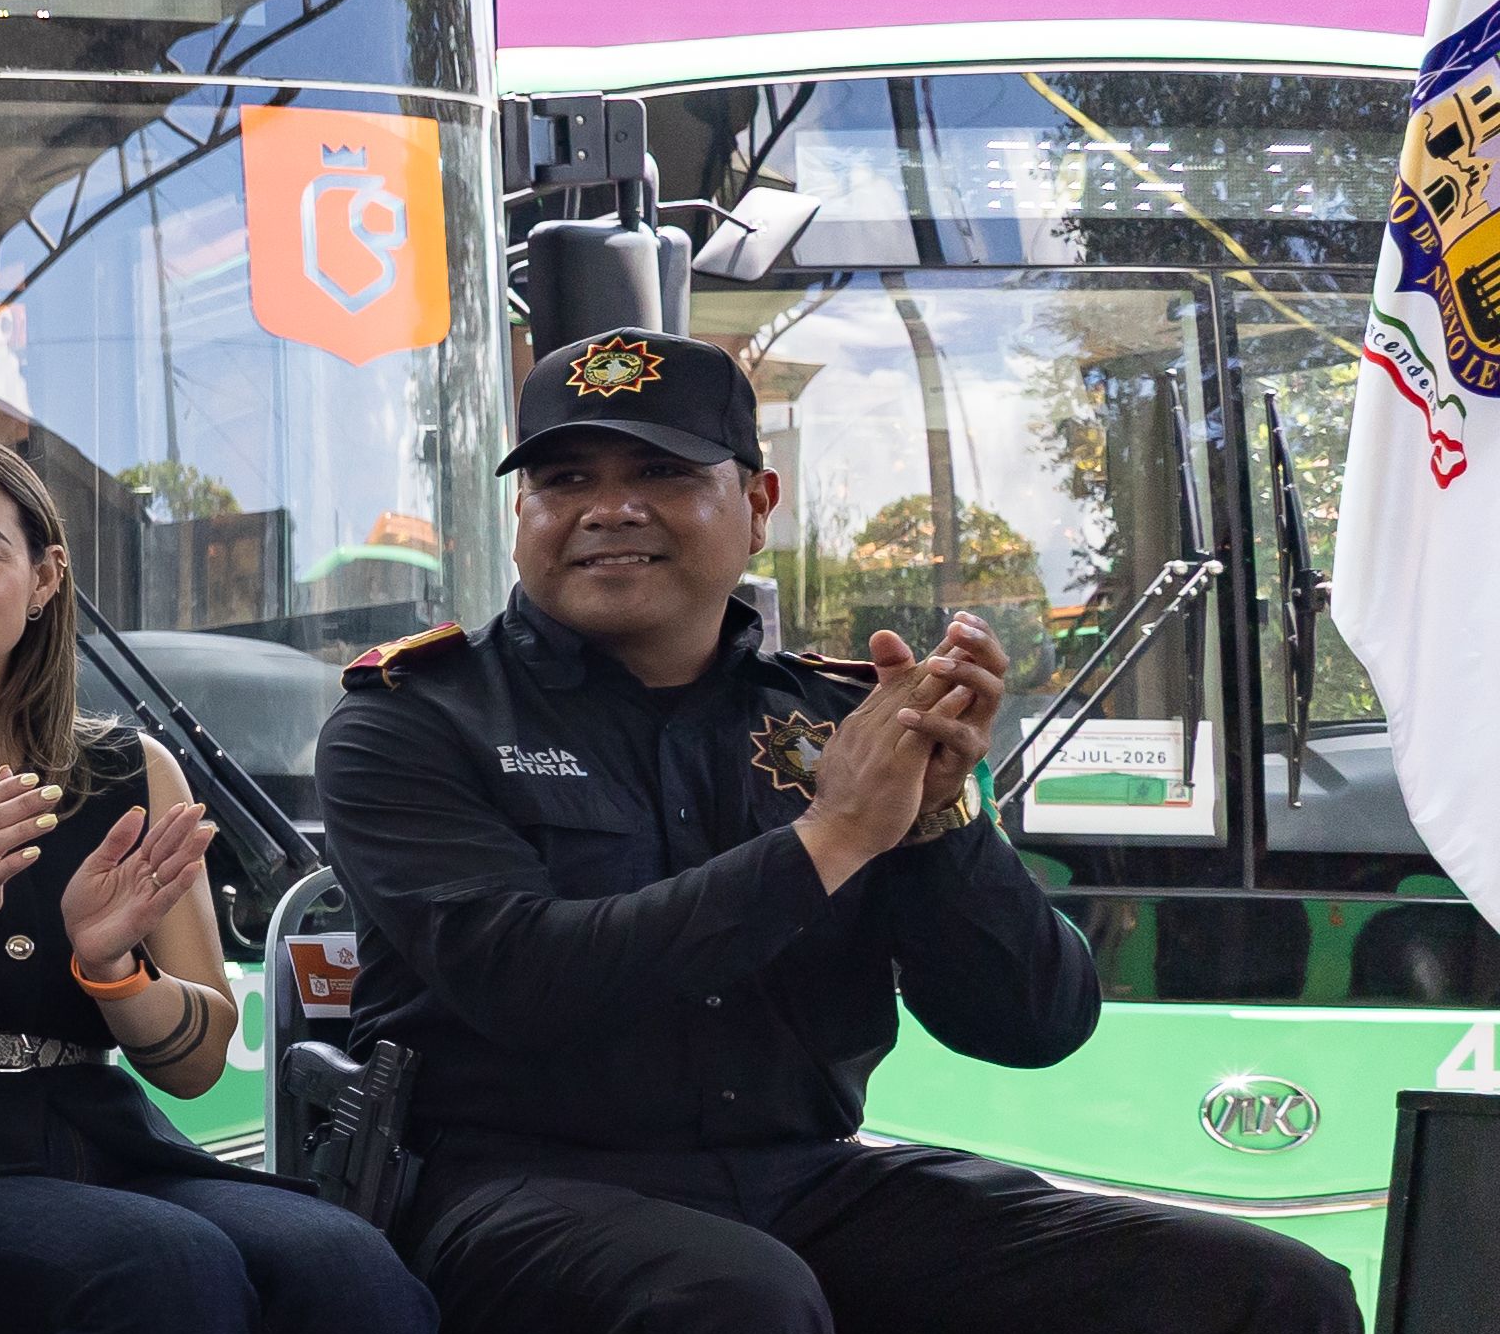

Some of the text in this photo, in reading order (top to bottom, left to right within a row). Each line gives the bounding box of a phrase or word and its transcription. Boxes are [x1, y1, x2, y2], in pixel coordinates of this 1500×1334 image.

[1411, 221, 1500, 389] DE NUEVO LE
[1059, 749, 1167, 765] 2-JUL-2026
